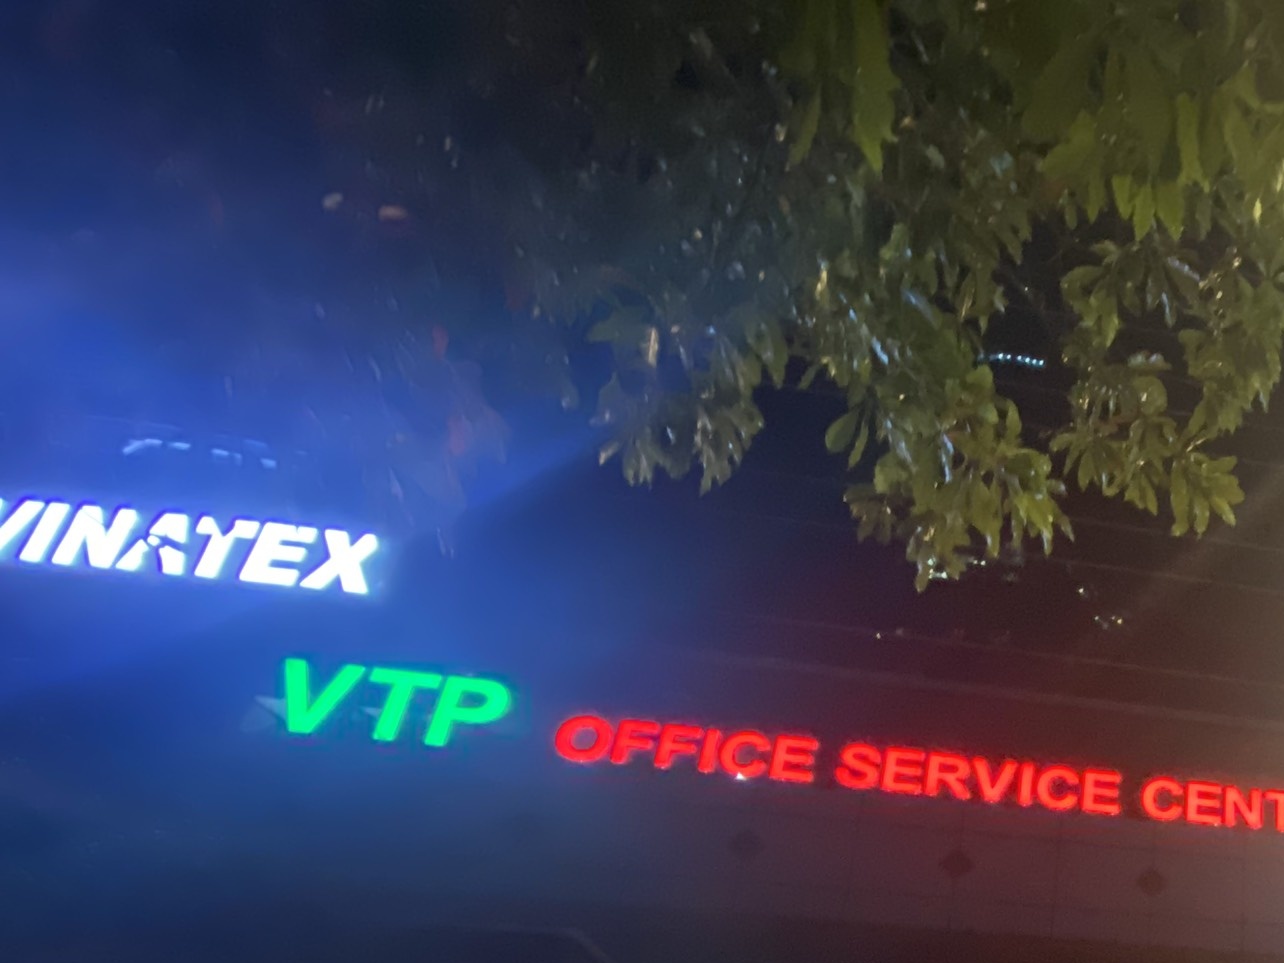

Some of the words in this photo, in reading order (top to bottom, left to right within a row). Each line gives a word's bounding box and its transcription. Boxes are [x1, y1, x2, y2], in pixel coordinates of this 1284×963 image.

[284, 657, 511, 748] VTP
[554, 713, 820, 784] OFFICE
[835, 741, 1122, 816] SERVICE
